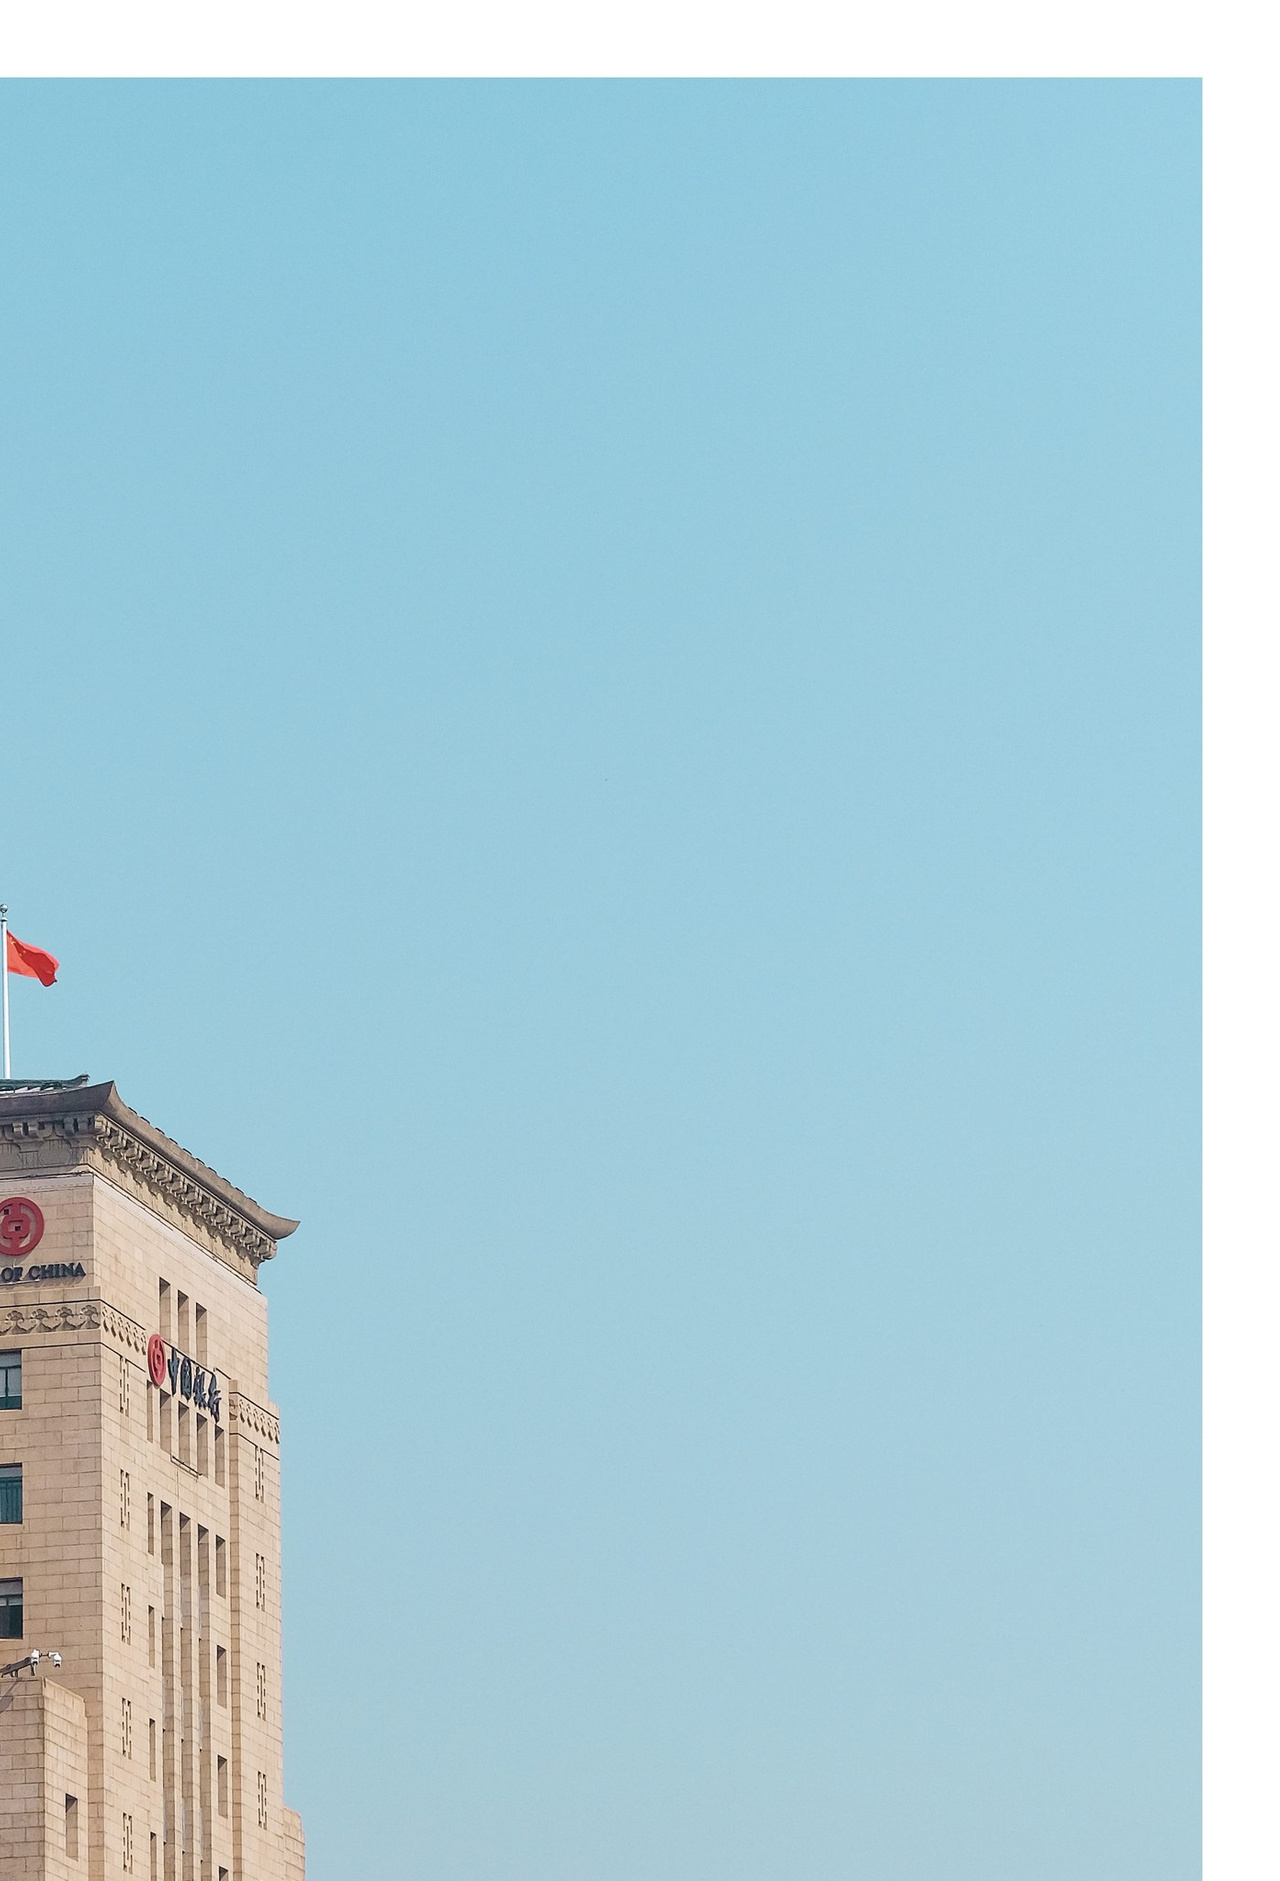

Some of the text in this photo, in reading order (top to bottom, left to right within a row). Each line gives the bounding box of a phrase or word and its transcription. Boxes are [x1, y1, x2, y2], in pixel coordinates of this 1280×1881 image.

[1, 1266, 24, 1283] OF
[28, 1262, 87, 1280] CHINA
[167, 1347, 222, 1425] 中国银行
